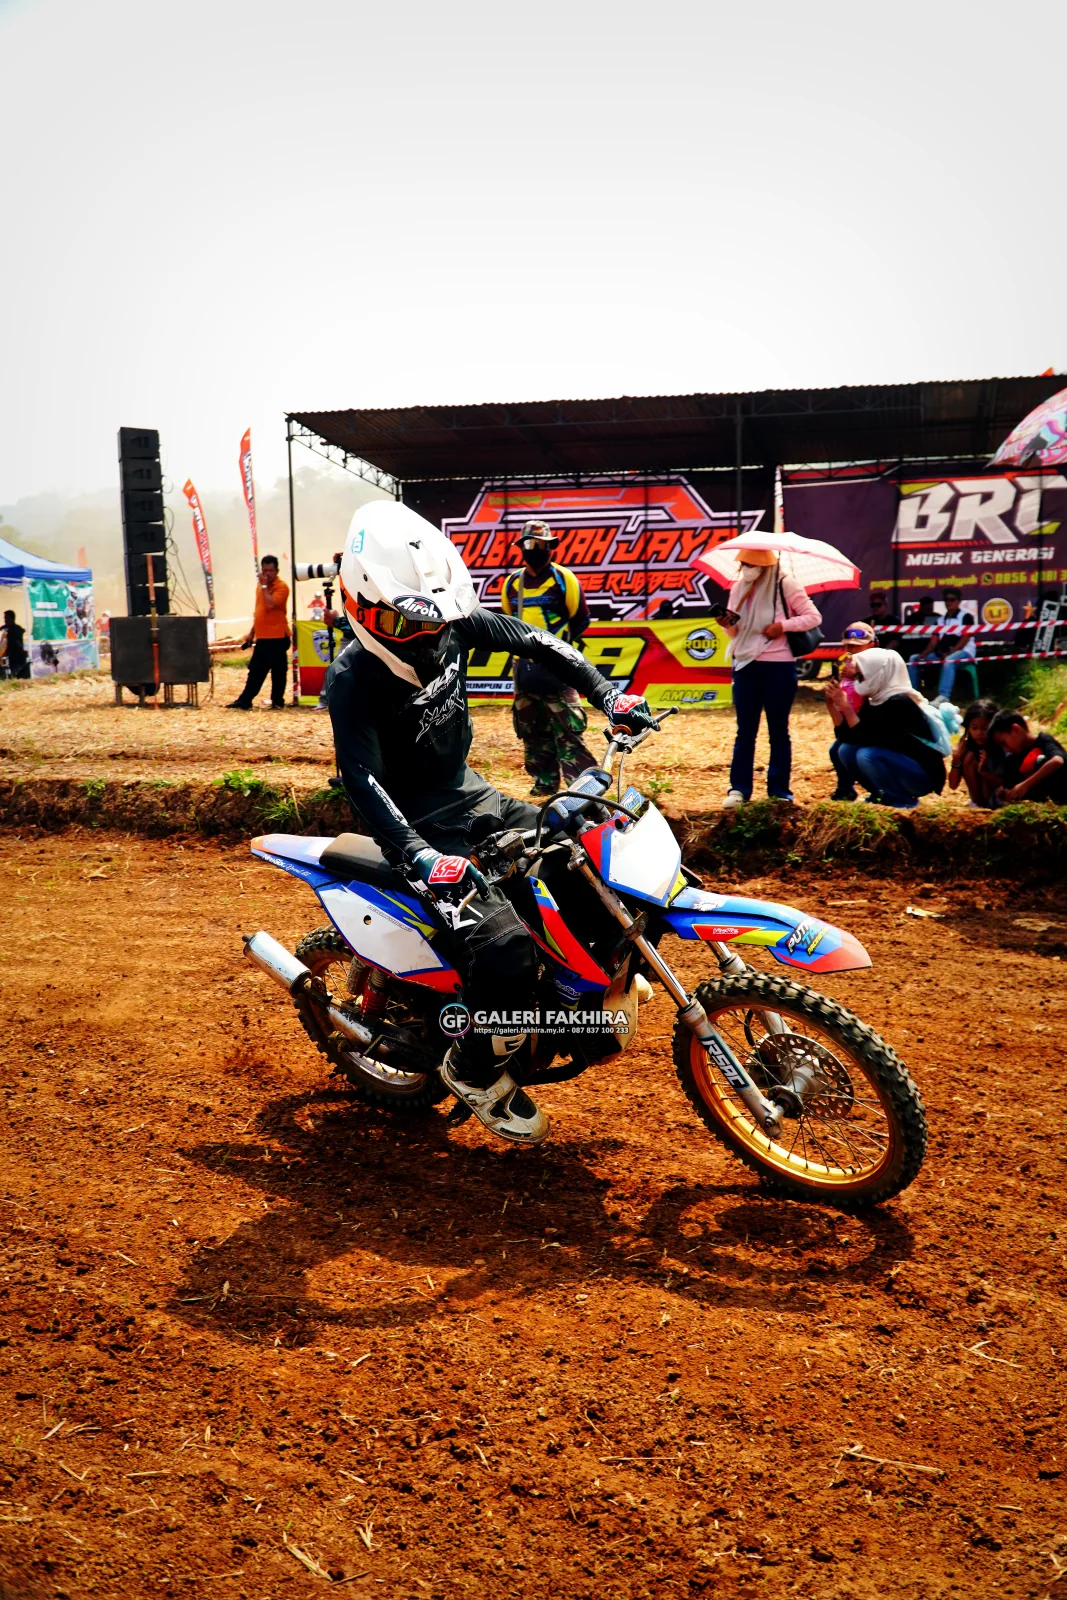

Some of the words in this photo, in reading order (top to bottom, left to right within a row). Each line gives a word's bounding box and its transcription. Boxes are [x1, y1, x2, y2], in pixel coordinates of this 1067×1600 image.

[891, 474, 1067, 544] BRC
[605, 569, 698, 594] RUBBER
[398, 598, 438, 618] Airoh
[684, 639, 720, 650] RODA
